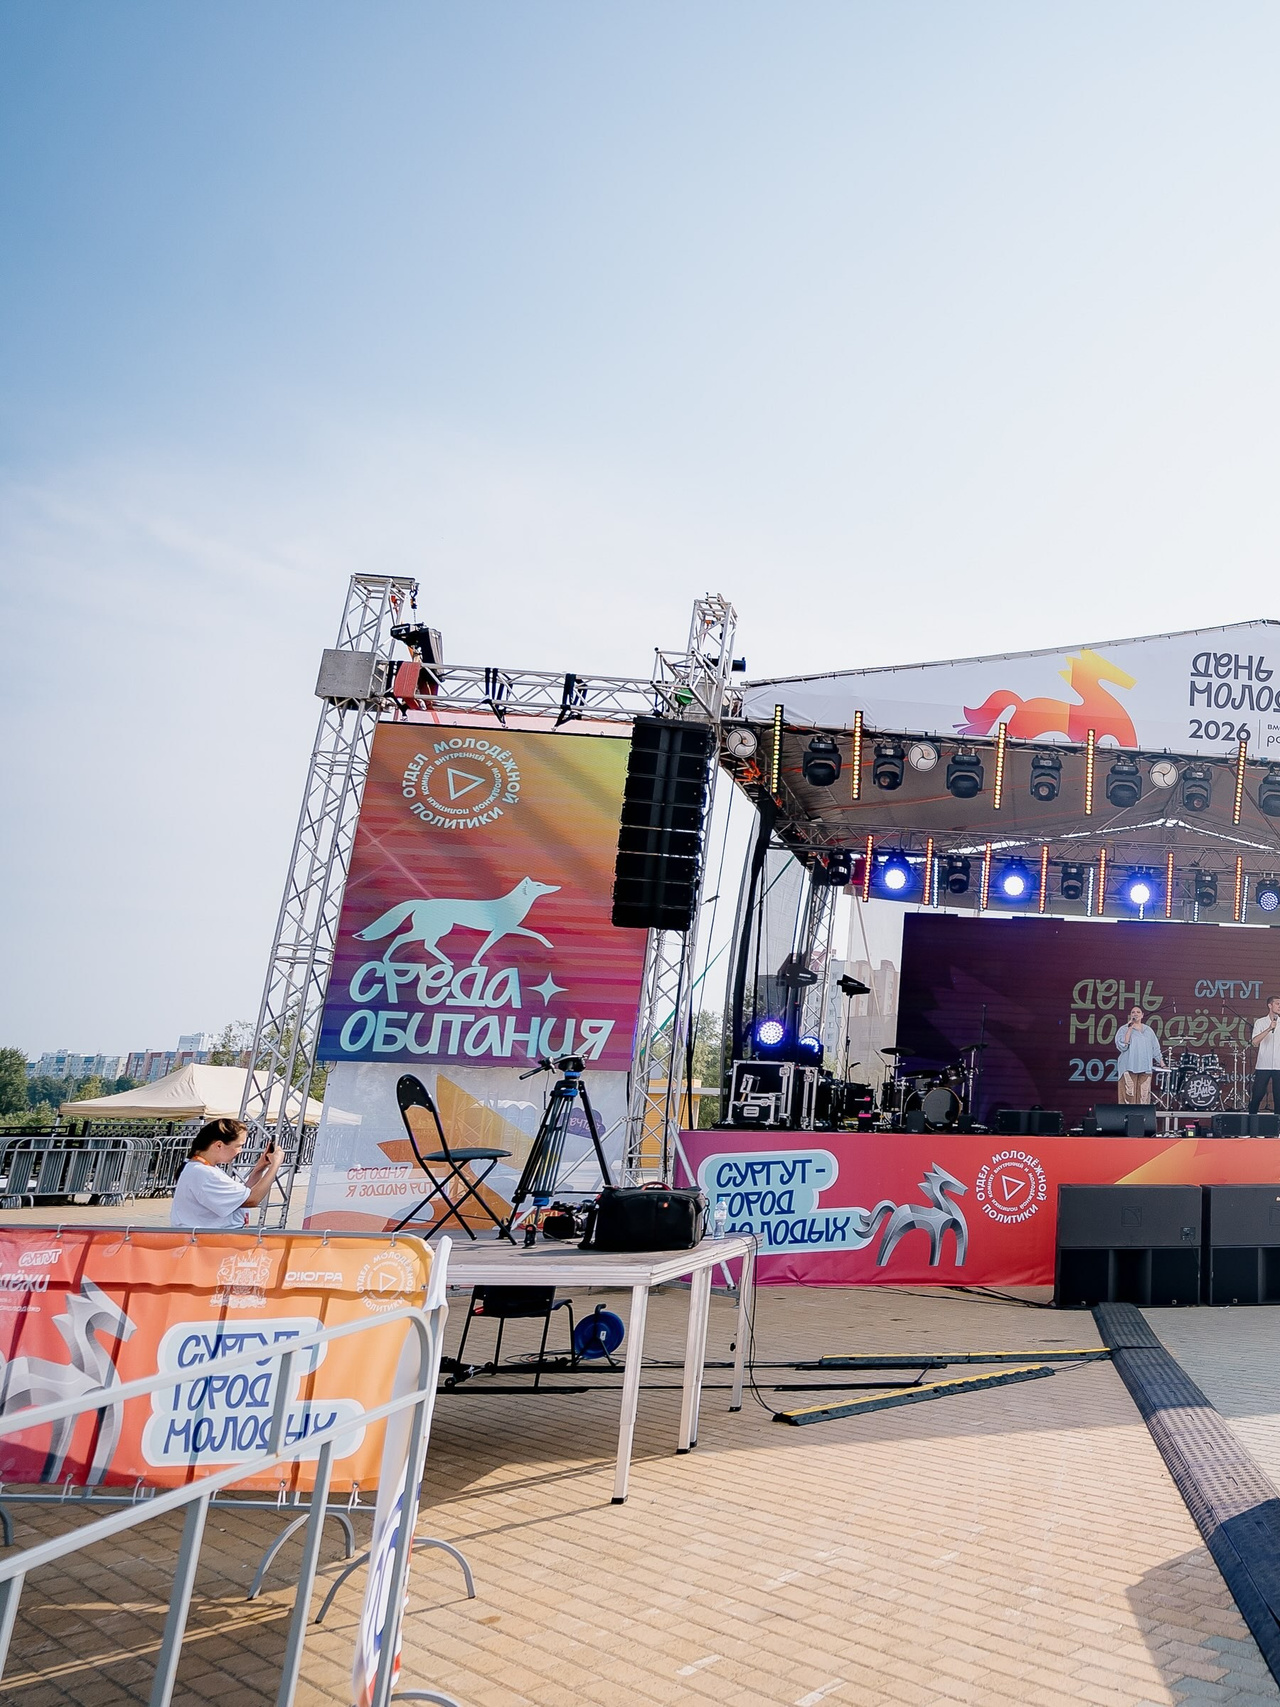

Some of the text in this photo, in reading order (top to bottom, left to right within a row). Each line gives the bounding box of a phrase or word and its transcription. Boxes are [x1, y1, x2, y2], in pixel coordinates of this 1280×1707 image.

[1188, 718, 1251, 742] 2026
[402, 738, 520, 829] ОТДЕЛ МОЛОДЁЖНОЙ ПОЛИТИКИ
[1194, 979, 1263, 999] СУРГУТ
[339, 1009, 615, 1061] ОБИТАНИЯ
[1068, 1058, 1119, 1082] 202
[346, 1184, 357, 1198] Я
[976, 1164, 990, 1201] ОТДЕЛ
[982, 1203, 1039, 1224] ПОЛИТИКИ
